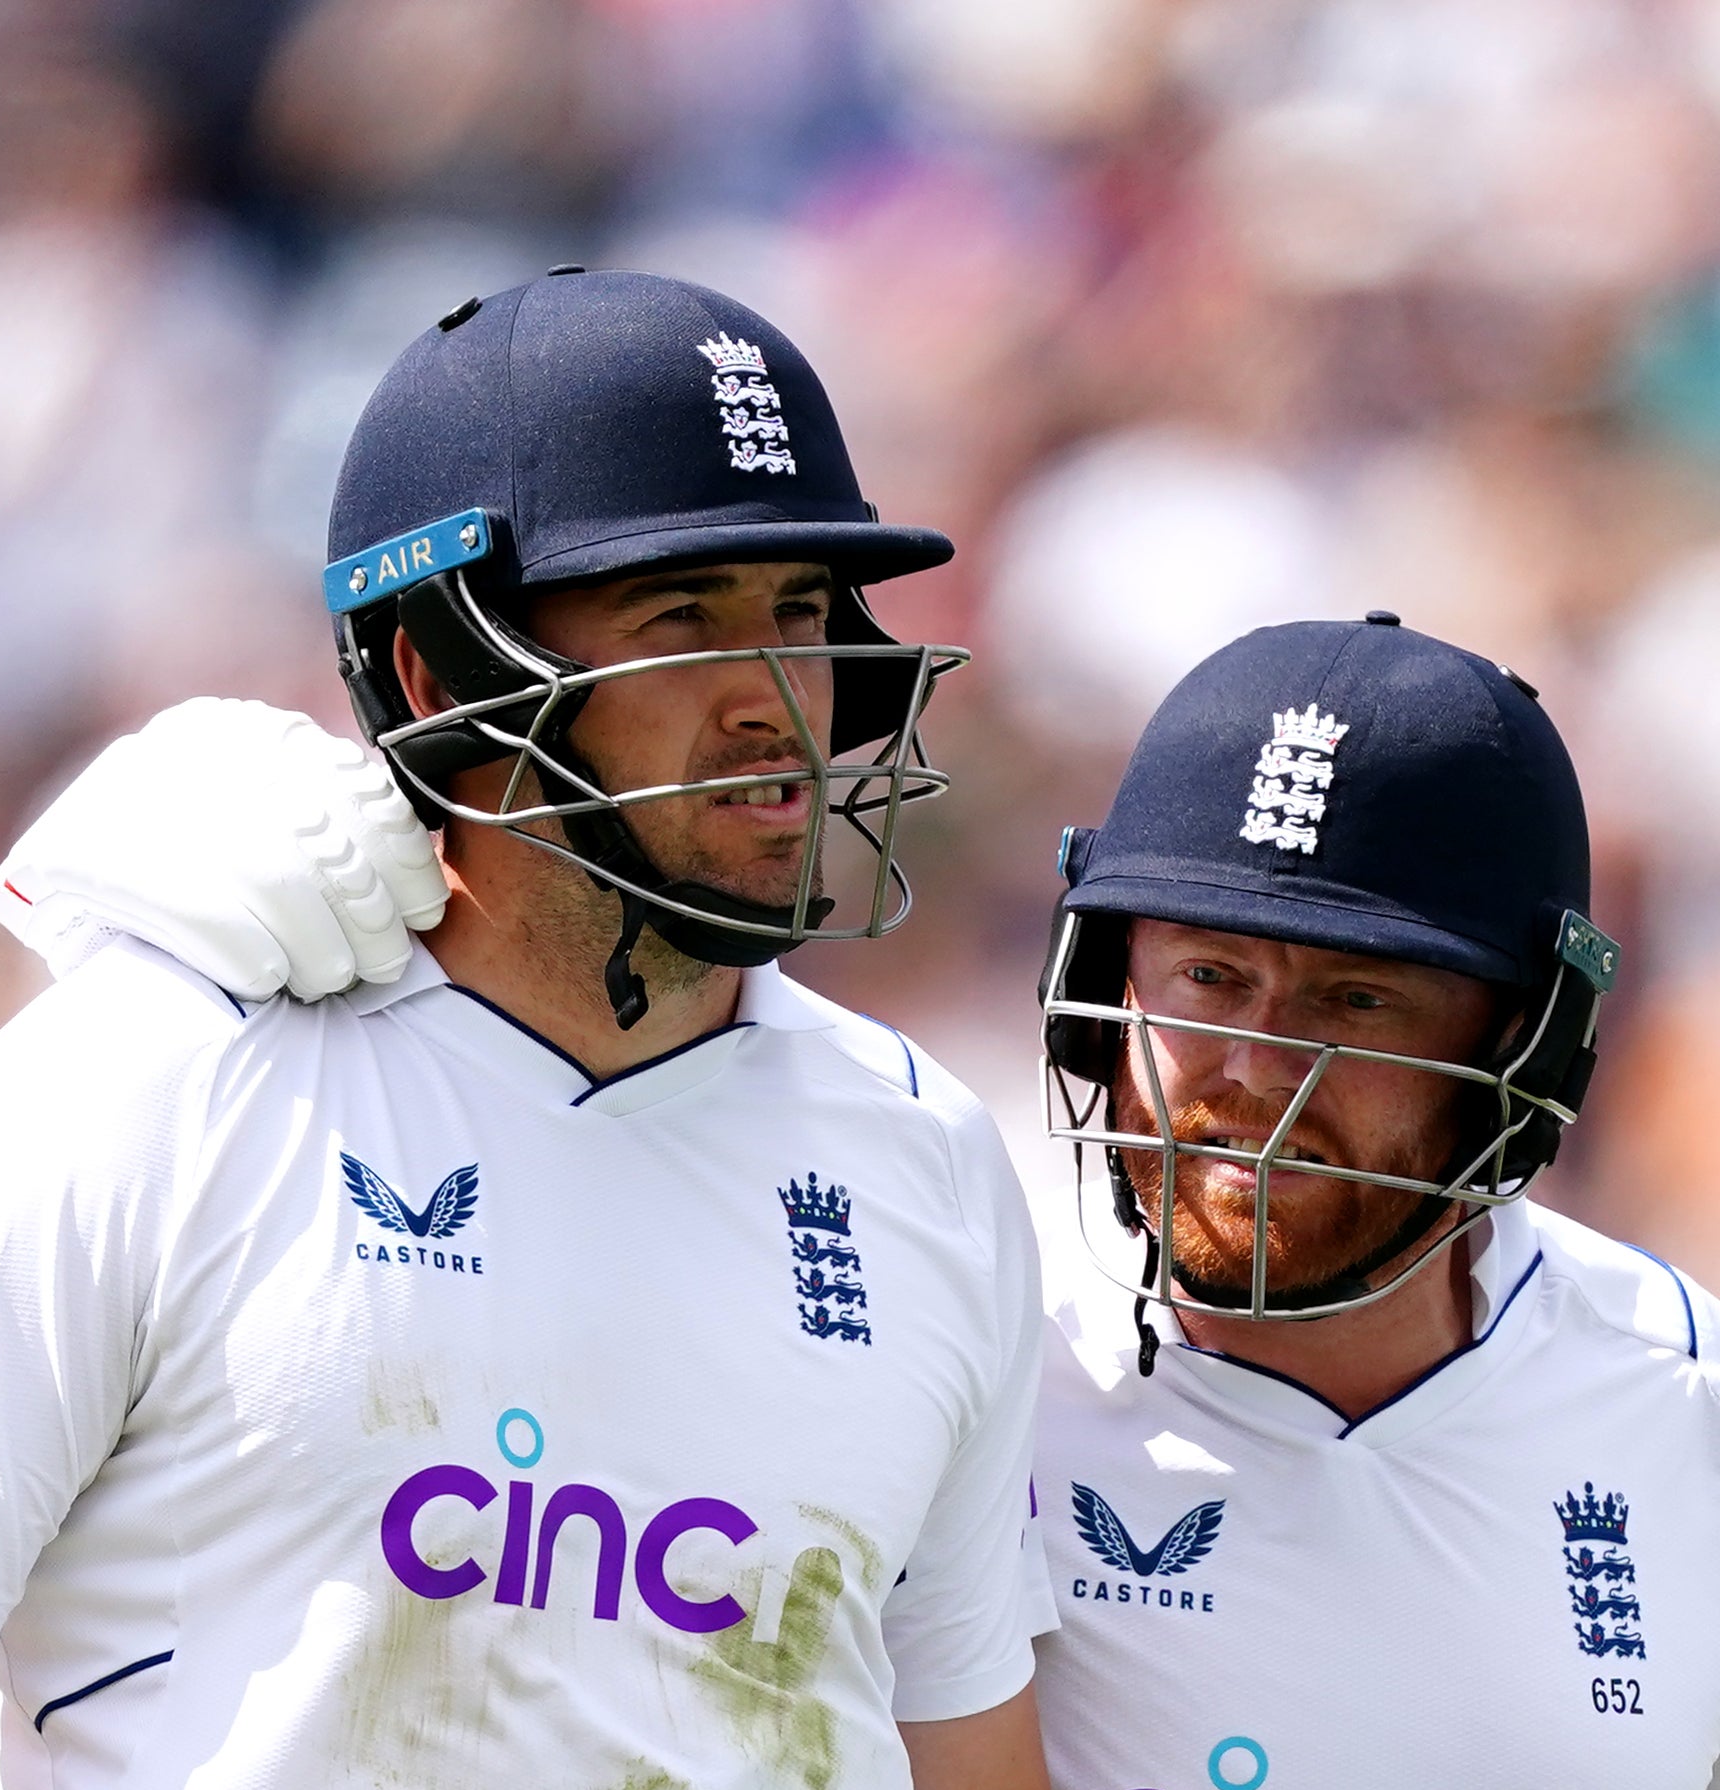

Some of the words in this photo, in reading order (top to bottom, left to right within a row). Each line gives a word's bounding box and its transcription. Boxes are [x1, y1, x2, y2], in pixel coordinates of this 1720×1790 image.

[378, 538, 434, 585] AIR
[356, 1243, 484, 1275] CASTORE
[1073, 1578, 1214, 1613] CASTORE
[1591, 1677, 1644, 1715] 652
